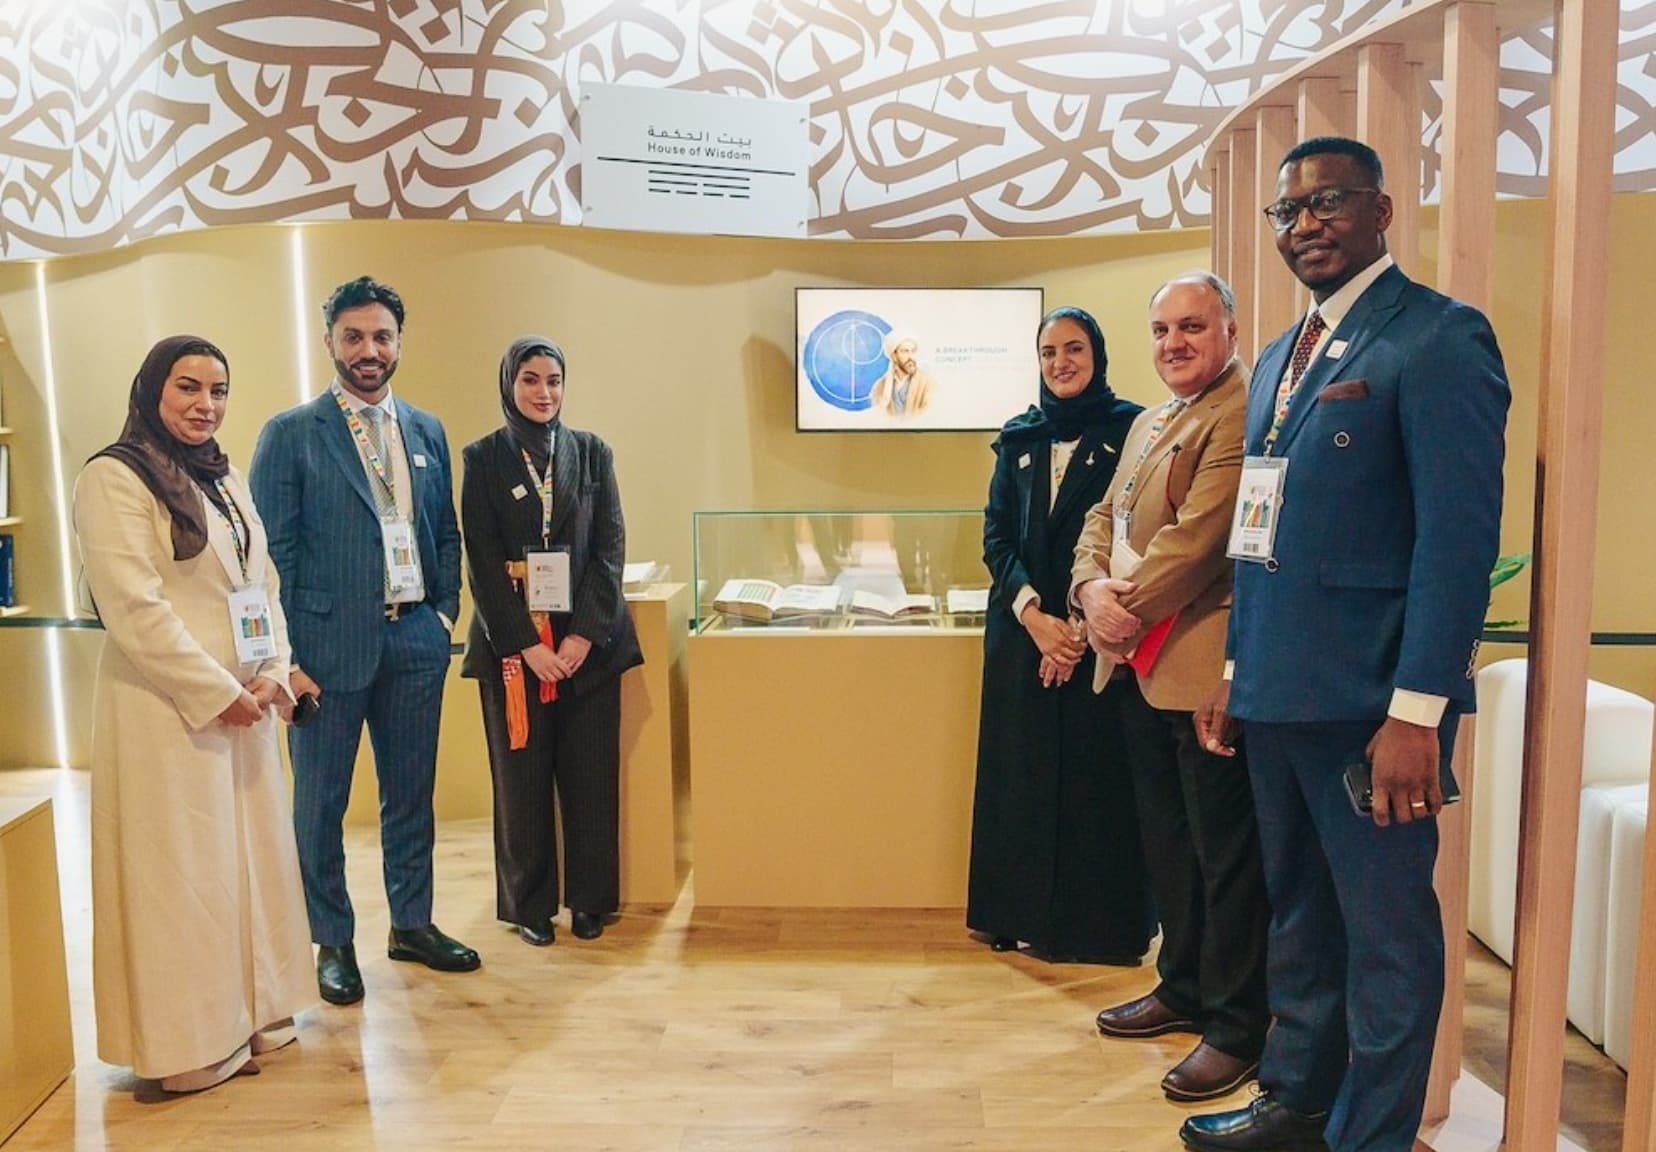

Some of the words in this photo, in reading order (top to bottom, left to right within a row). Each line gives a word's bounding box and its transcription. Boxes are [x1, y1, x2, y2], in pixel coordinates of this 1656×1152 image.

[648, 125, 709, 142] الحكمة
[716, 132, 752, 147] بيت
[648, 142, 686, 155] House
[689, 144, 701, 156] of
[706, 147, 751, 160] Wisdom
